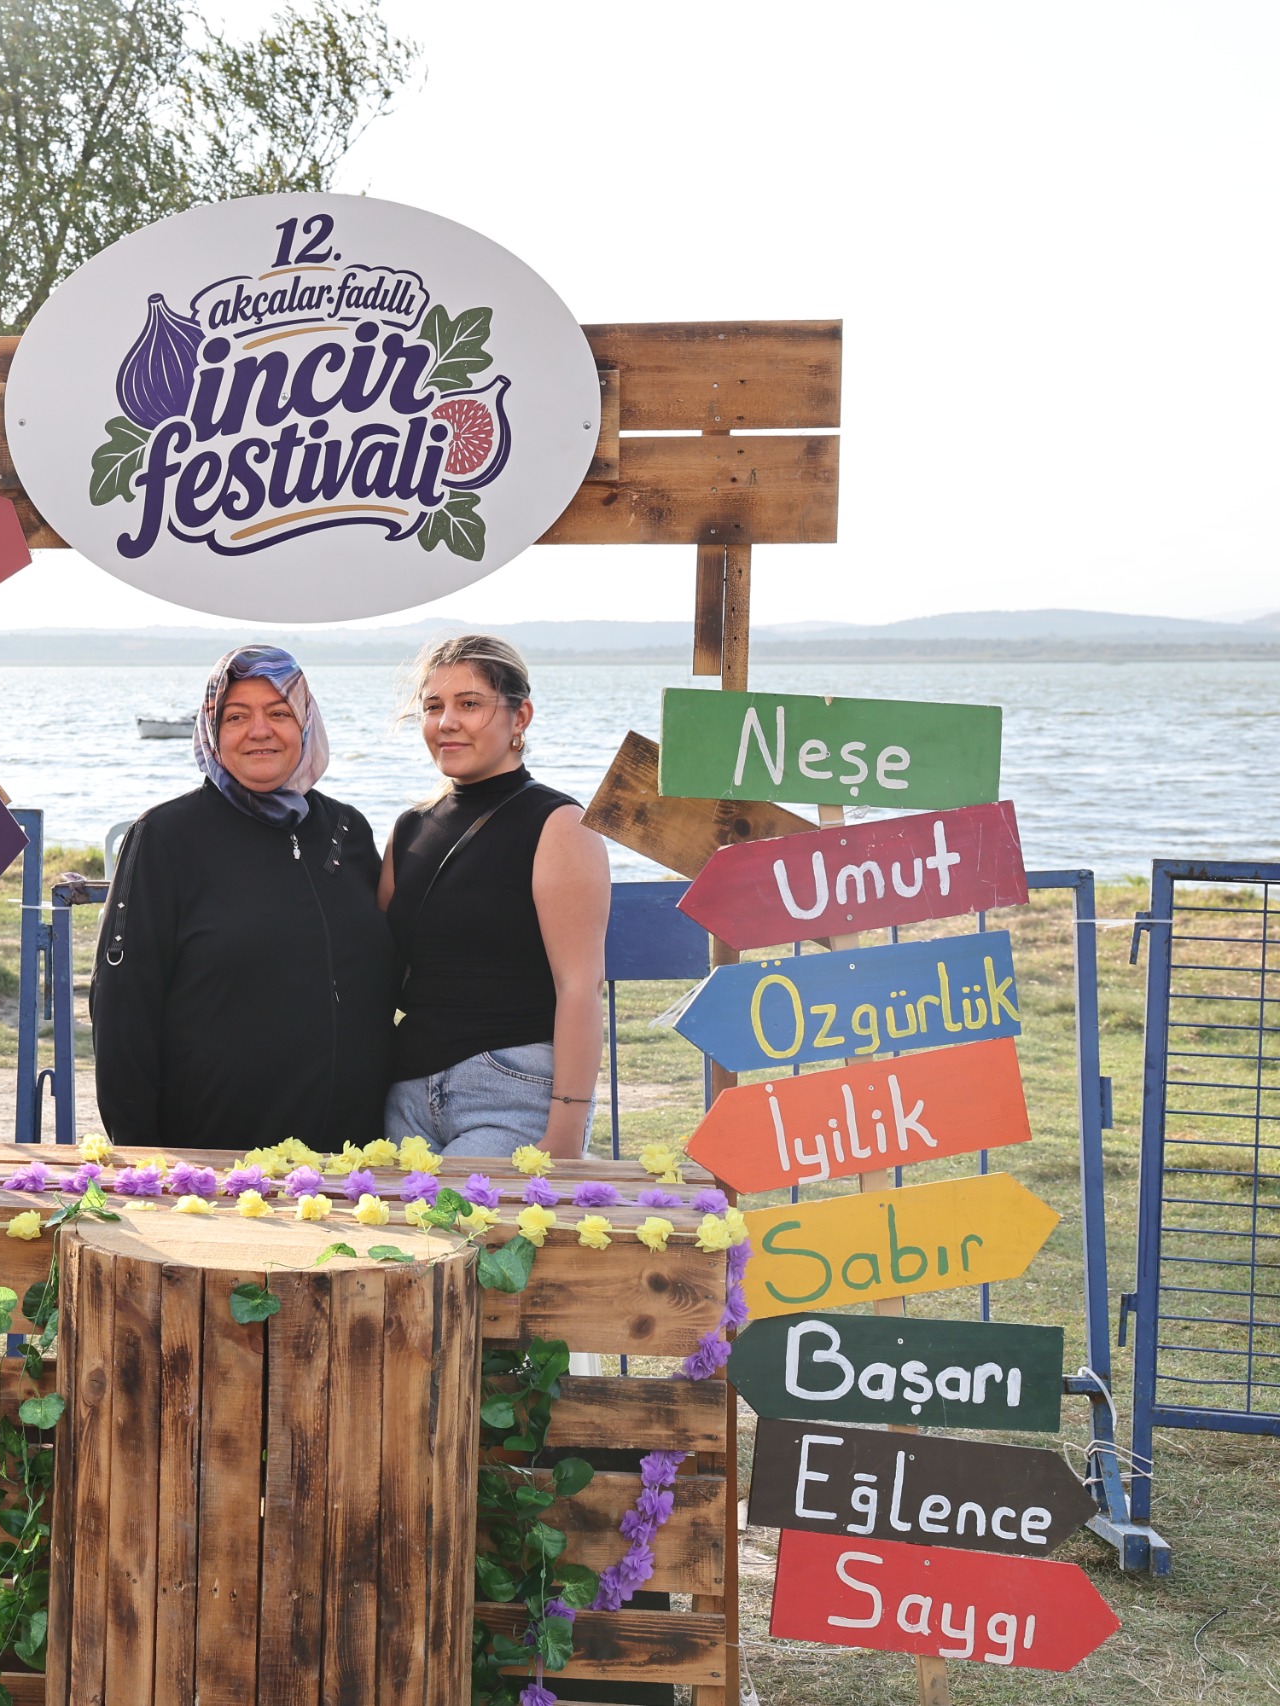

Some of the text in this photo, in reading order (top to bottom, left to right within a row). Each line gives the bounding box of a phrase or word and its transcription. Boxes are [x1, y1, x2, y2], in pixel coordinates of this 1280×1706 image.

[271, 213, 342, 268] 12.
[191, 321, 435, 442] incir
[116, 419, 449, 559] festivali
[733, 705, 911, 797] Neşe
[773, 820, 961, 921] Umut
[750, 956, 1020, 1060] Özgürlük
[764, 1074, 938, 1186] İyilik
[761, 1203, 984, 1304] Sabır
[785, 1320, 1022, 1415] Başarı
[794, 1434, 1053, 1545] Eğlence
[827, 1551, 1036, 1666] Saygı
